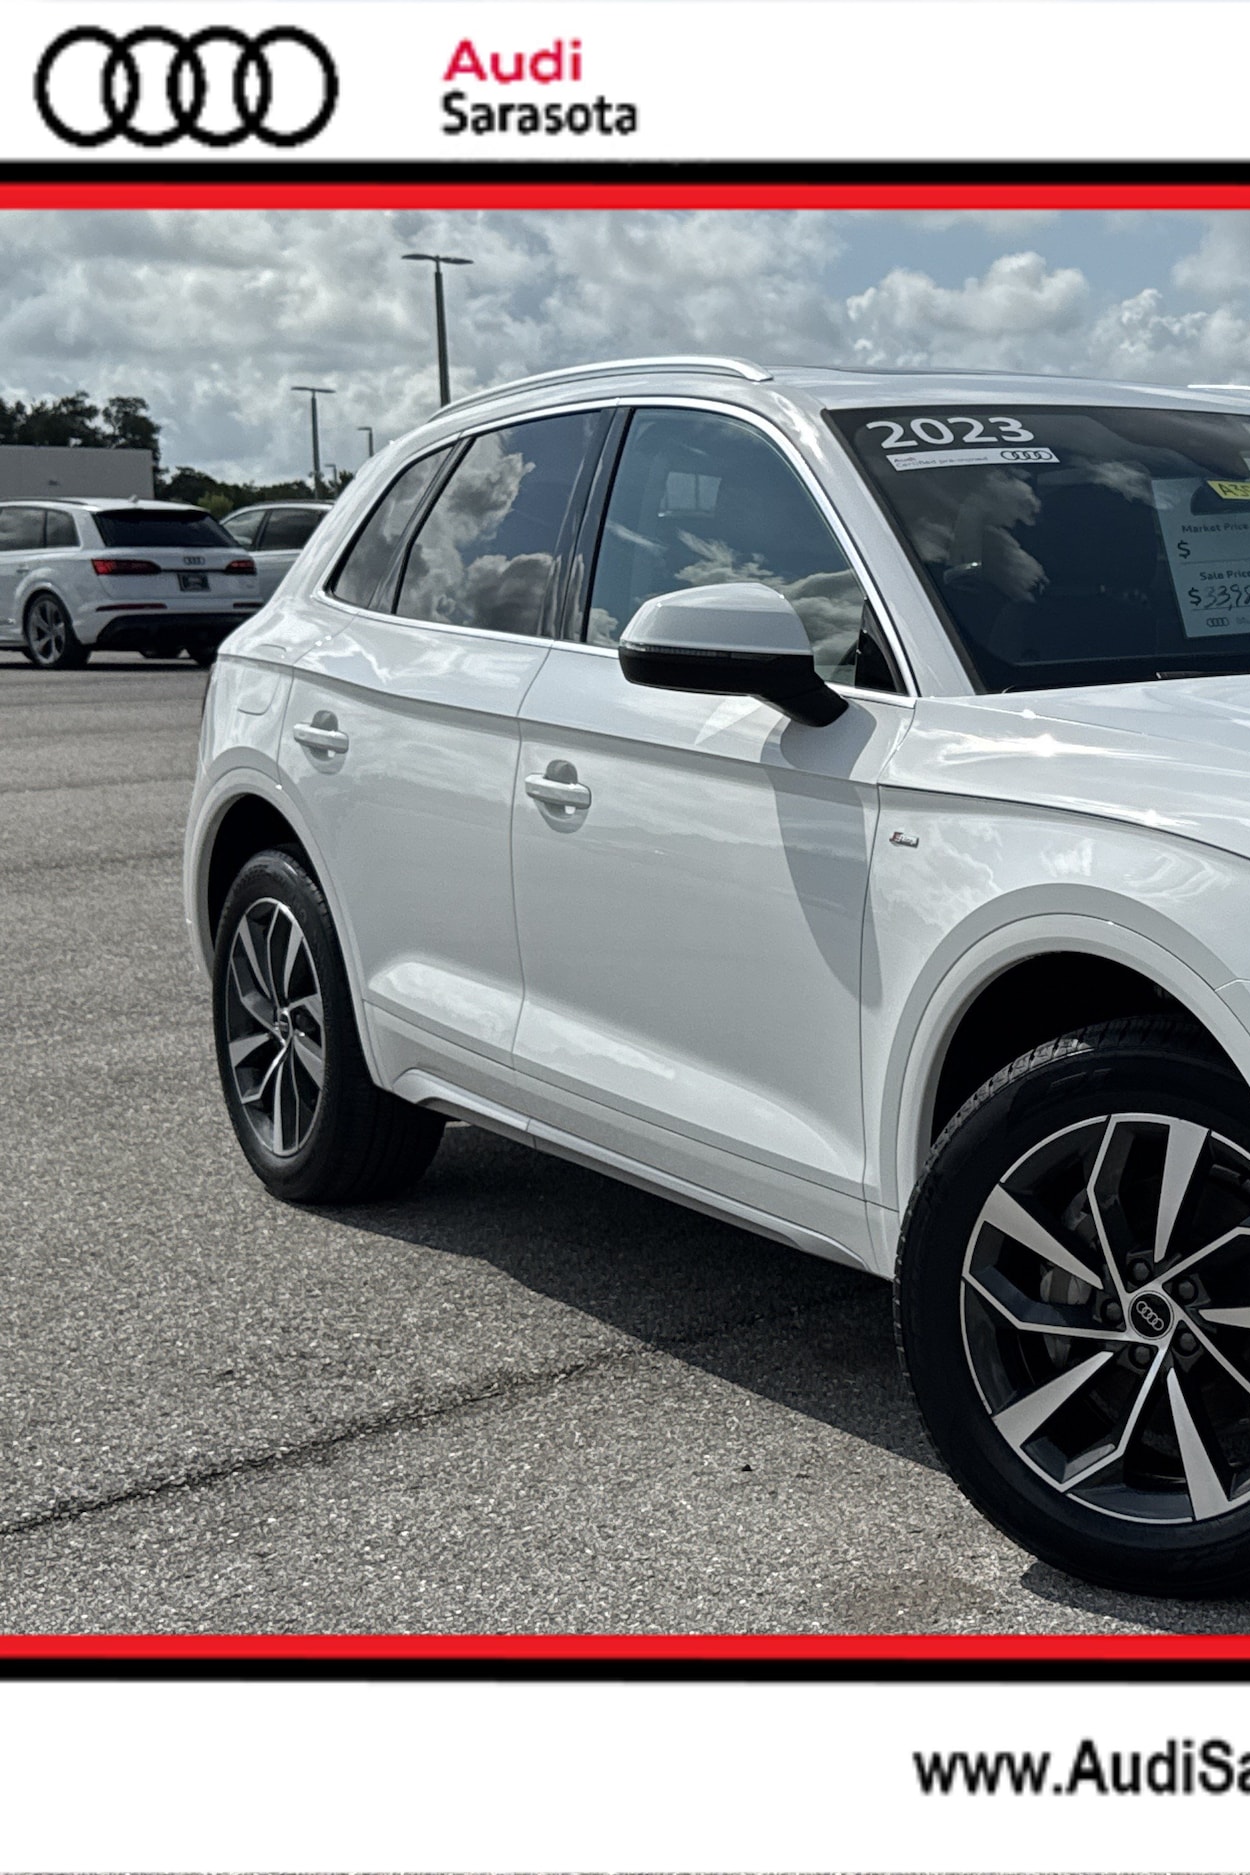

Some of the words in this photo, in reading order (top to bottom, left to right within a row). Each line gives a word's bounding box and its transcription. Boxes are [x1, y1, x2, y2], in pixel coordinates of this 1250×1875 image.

[866, 417, 1035, 449] 2023
[1181, 523, 1221, 534] Market
[1224, 522, 1250, 532] Price
[1177, 540, 1191, 559] $
[1199, 571, 1224, 582] Sale
